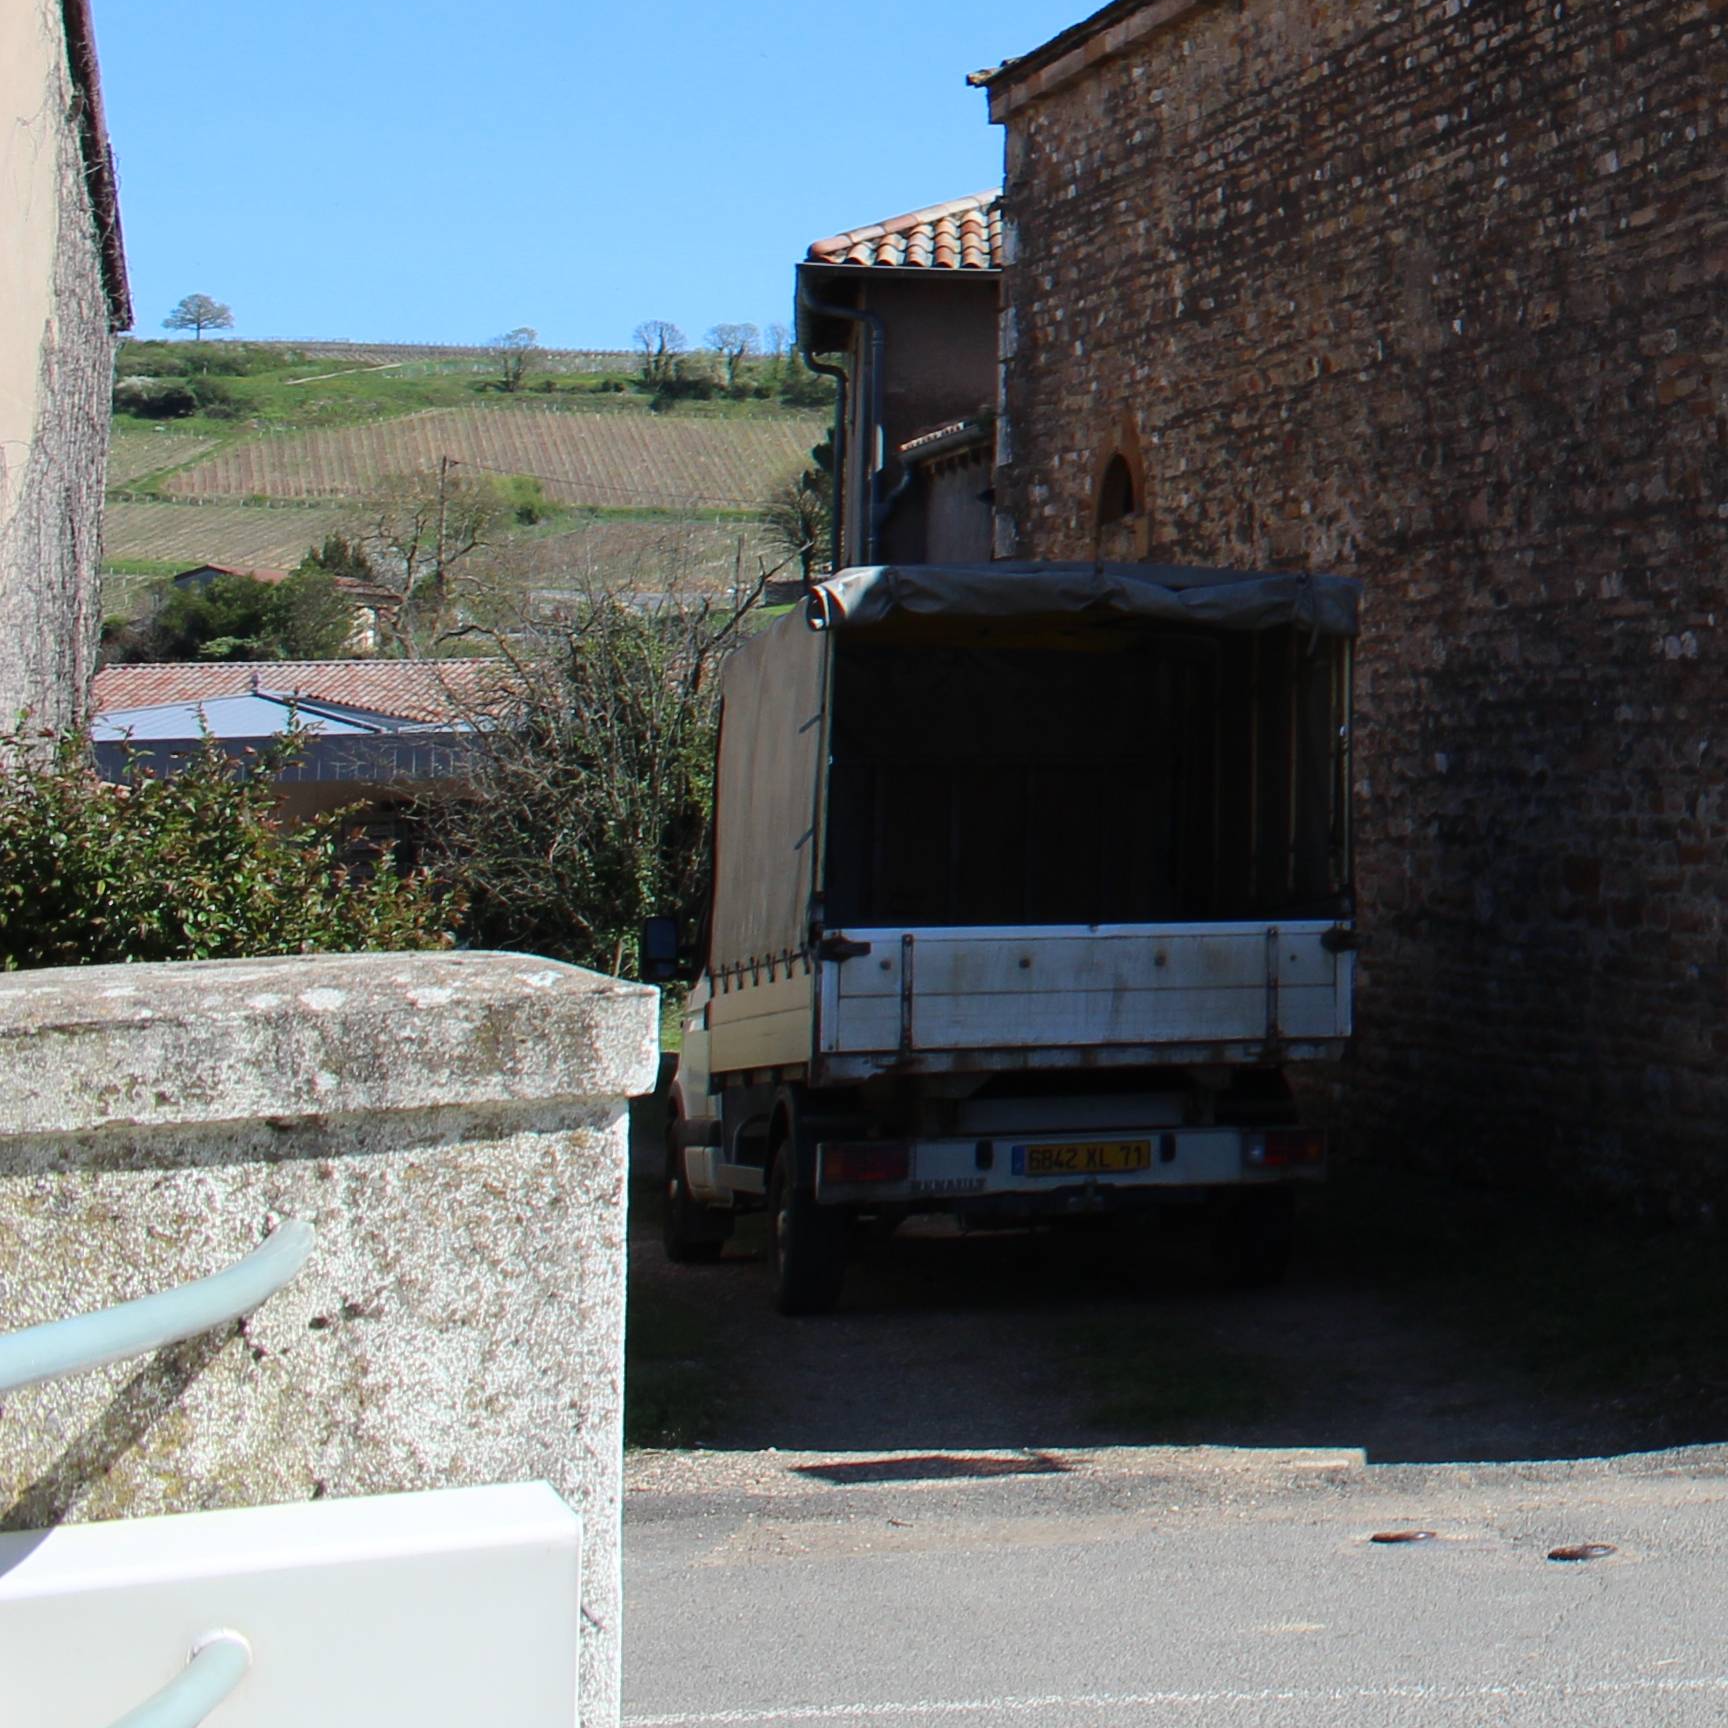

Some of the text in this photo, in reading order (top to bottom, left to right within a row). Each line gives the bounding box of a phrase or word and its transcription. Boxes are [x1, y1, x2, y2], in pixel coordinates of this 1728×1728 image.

[1028, 1143, 1141, 1170] 6842 XL 71
